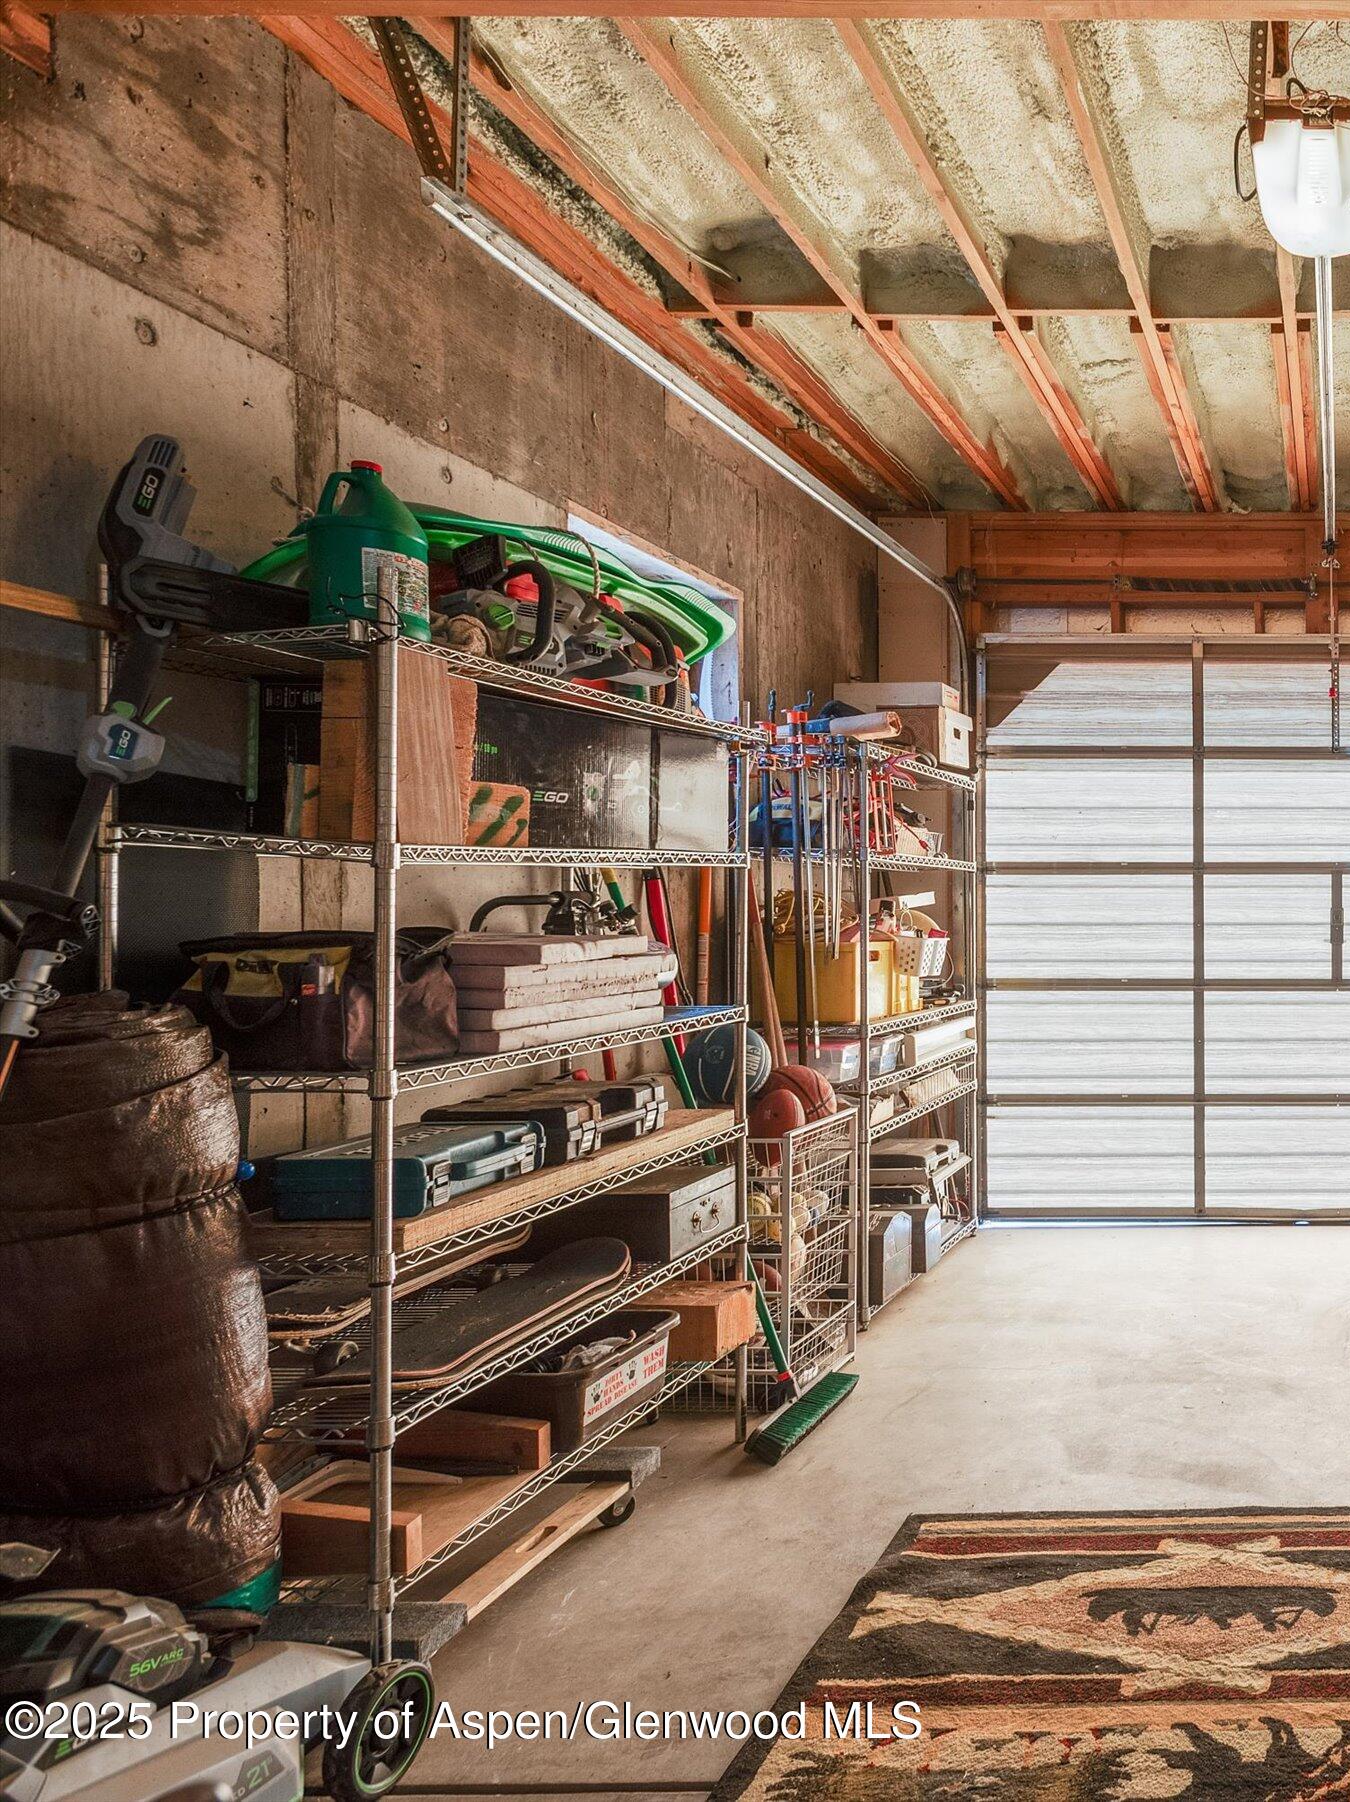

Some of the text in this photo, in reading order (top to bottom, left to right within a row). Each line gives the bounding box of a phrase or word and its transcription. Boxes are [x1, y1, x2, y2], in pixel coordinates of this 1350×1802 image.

[137, 474, 159, 510] EGO
[115, 730, 131, 757] EGO
[532, 790, 569, 804] EGO
[642, 1344, 665, 1366] WASH
[643, 1358, 665, 1379] THEM
[130, 1654, 162, 1678] 56V
